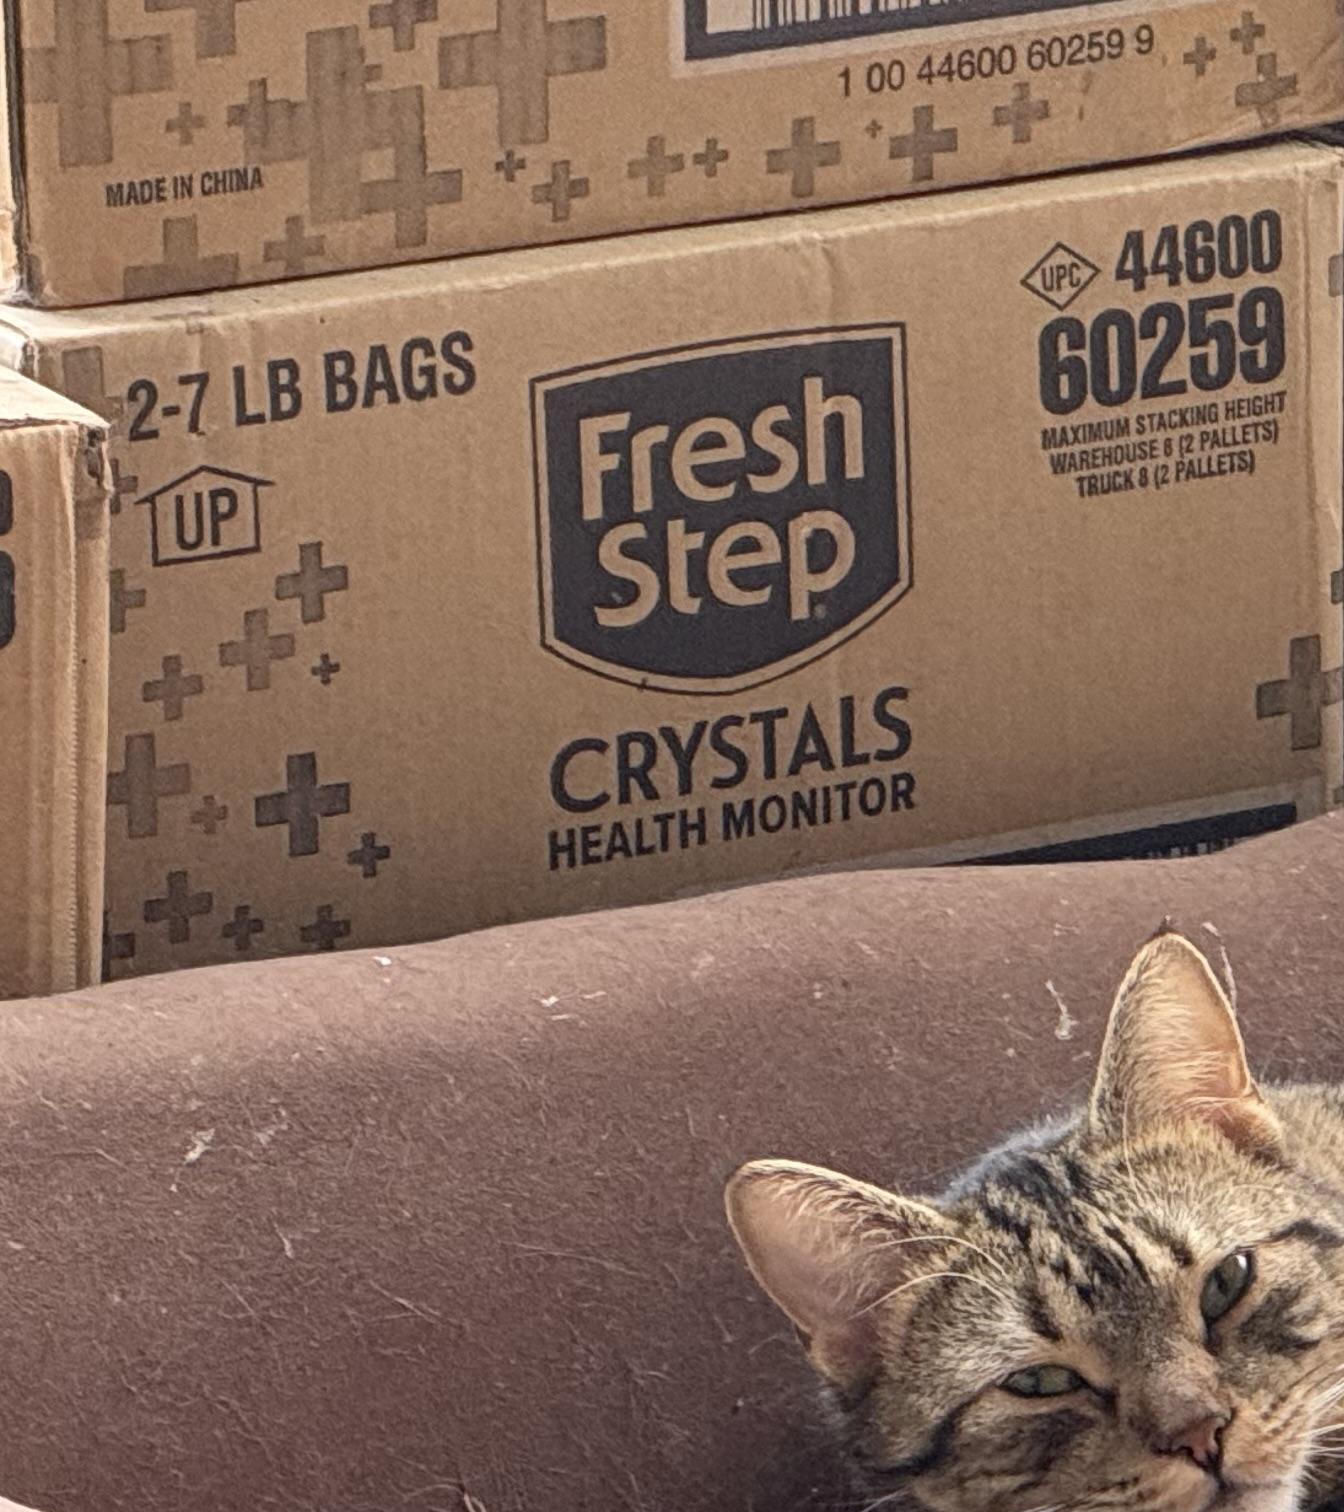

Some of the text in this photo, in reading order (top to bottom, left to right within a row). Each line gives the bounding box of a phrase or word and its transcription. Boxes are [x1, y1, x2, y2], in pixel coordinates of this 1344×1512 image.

[838, 24, 1155, 97] 1 00 44600 60259 9
[106, 167, 263, 206] MADE IN CHINA
[1040, 262, 1081, 293] UPC
[1115, 210, 1282, 291] 44600
[127, 330, 477, 441] 2-7 LB BAGS
[1039, 287, 1286, 415] 60259
[579, 375, 864, 521] Fresh
[1041, 391, 1287, 449] MAXIMUM STACKING HEIGHT
[1051, 439, 1159, 474] WAREHOUSE
[1179, 433, 1194, 458] (2
[1200, 419, 1279, 450] PALLETS)
[1077, 470, 1134, 498] TRUCK
[1154, 464, 1170, 489] (2
[1175, 449, 1255, 482] PALLETS)
[174, 486, 238, 550] UP
[594, 510, 856, 628] Step
[549, 686, 913, 813] CRYSTALS
[547, 771, 917, 870] HEALTH MONITOR
